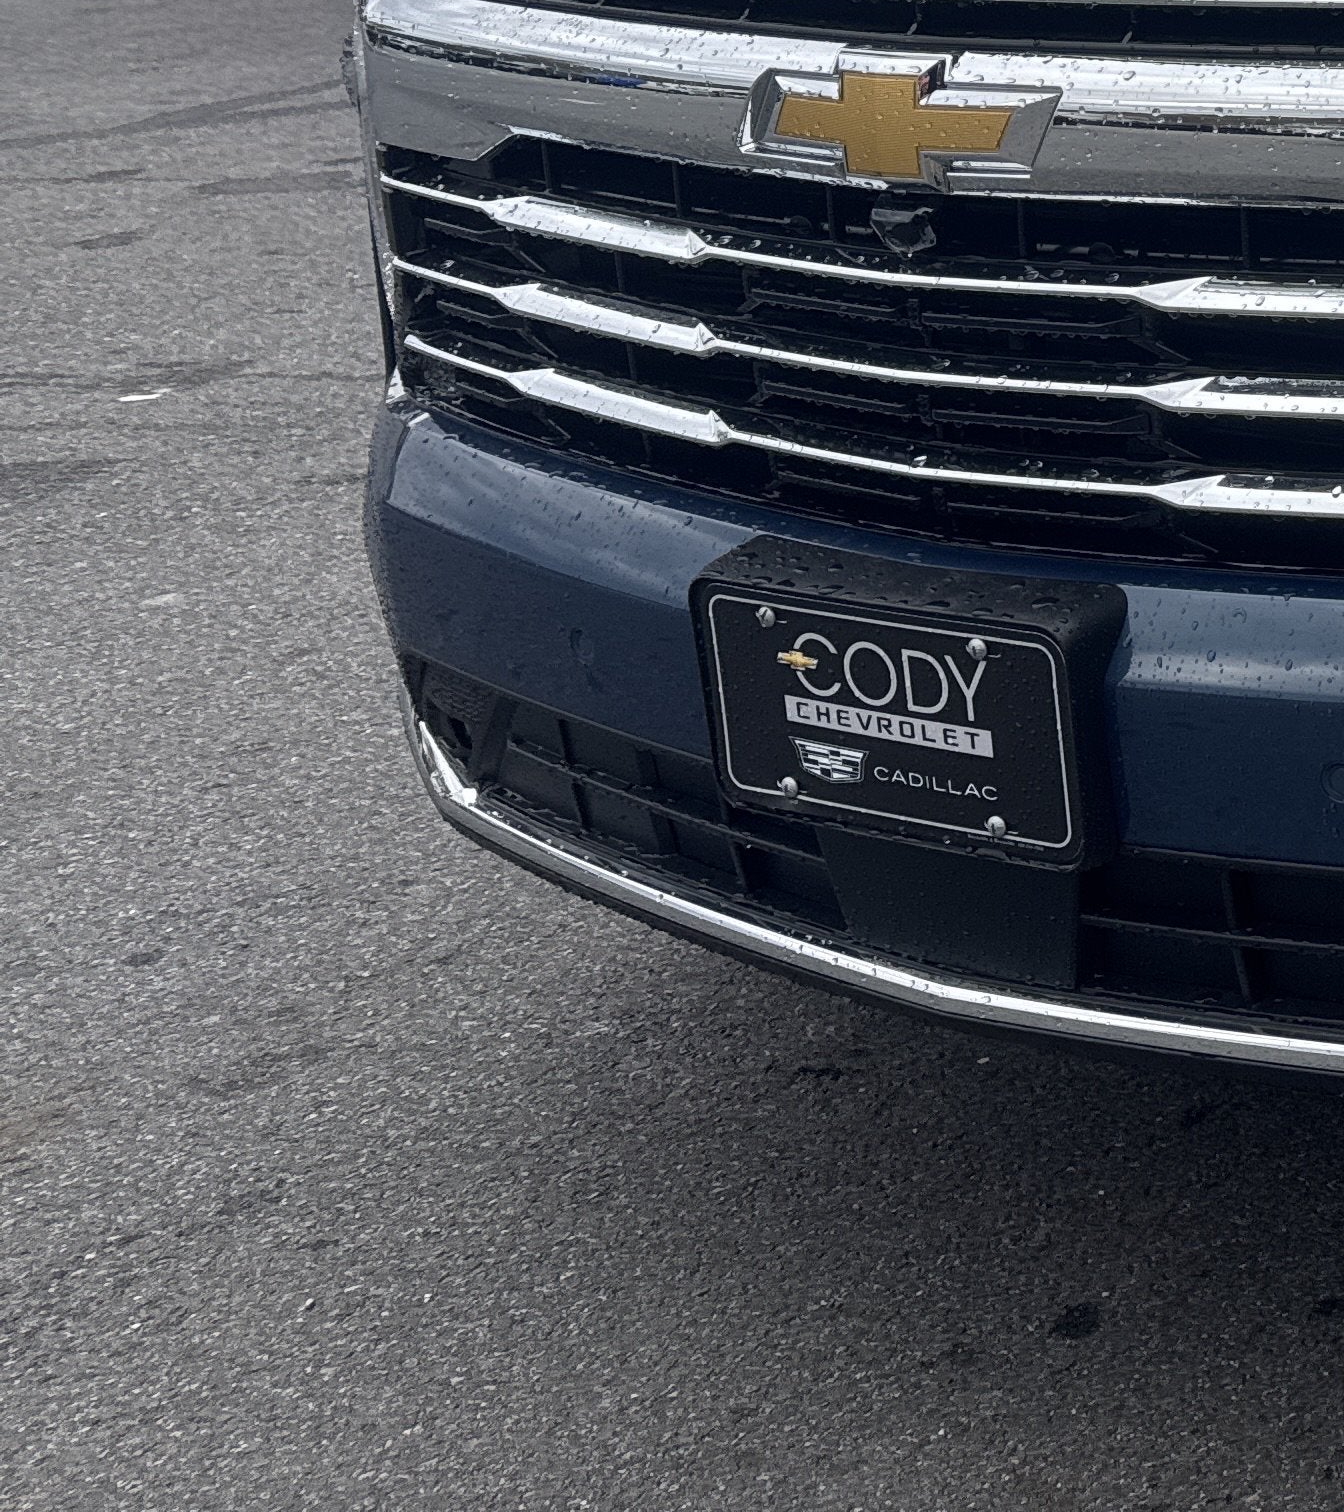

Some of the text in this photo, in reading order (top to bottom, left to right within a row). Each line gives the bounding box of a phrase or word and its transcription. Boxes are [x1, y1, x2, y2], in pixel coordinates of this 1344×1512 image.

[792, 632, 987, 722] CODY
[796, 701, 980, 750] CHEVROLET
[873, 765, 999, 802] CADILLAC
